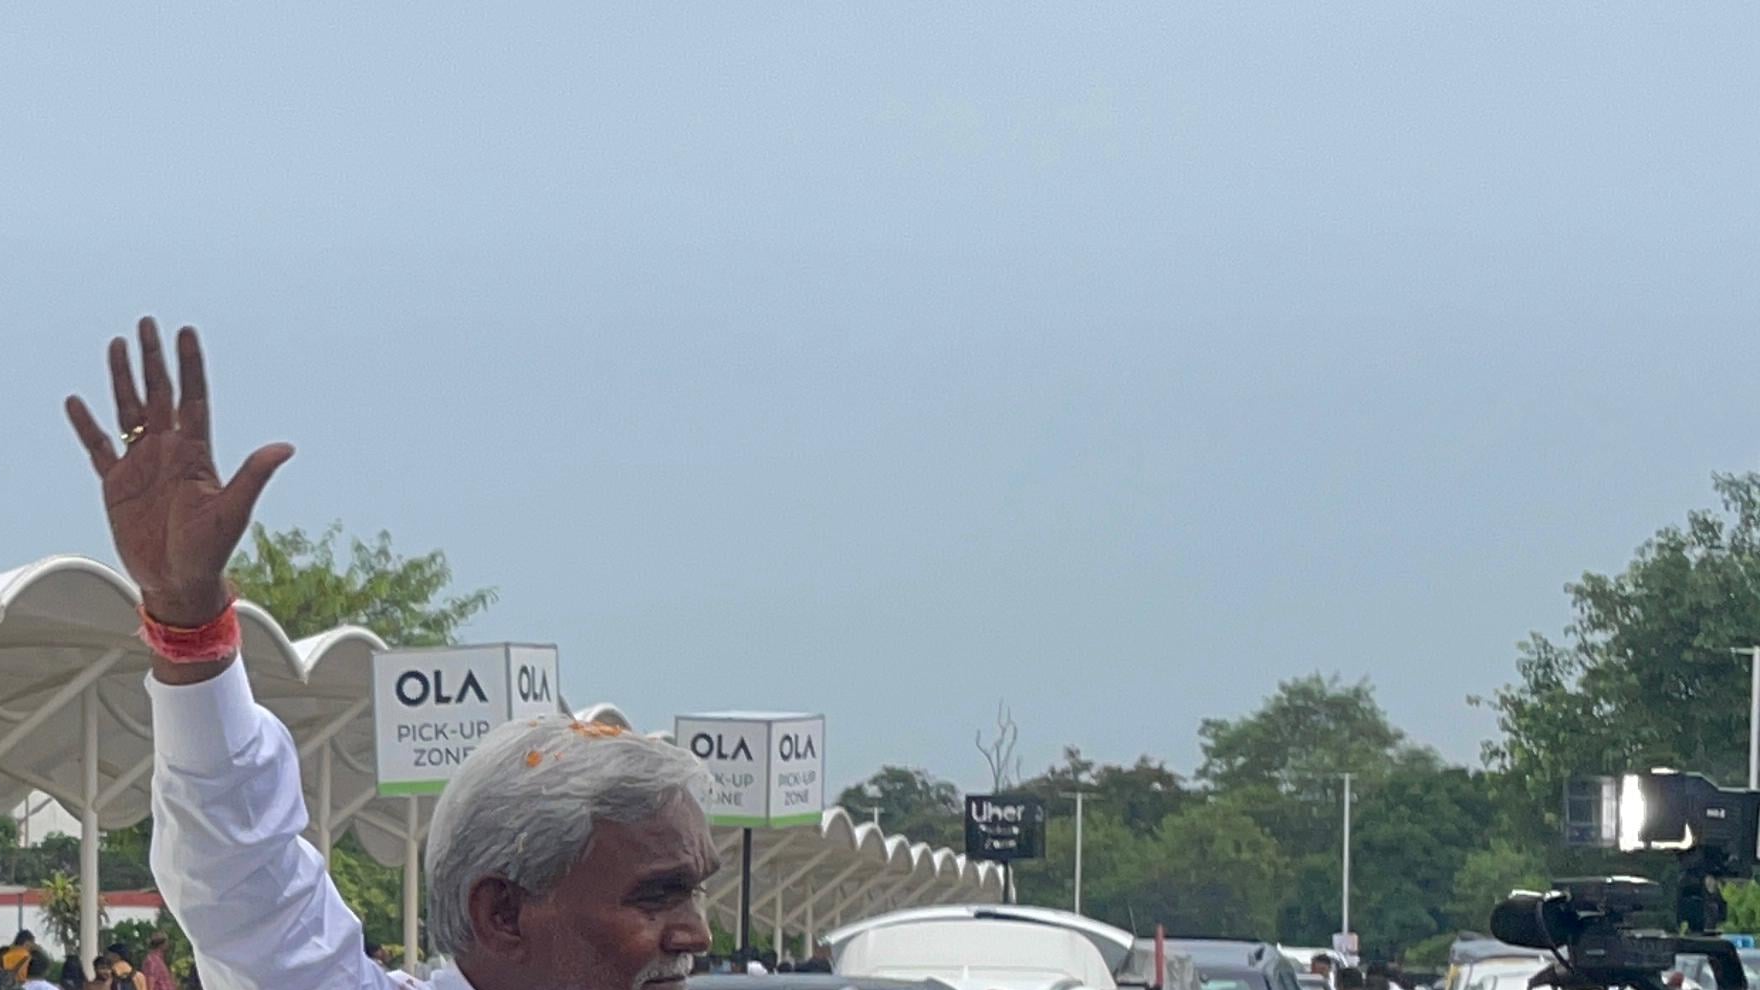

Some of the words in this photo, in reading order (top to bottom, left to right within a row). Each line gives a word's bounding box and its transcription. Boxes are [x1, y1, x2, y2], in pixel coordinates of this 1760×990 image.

[395, 669, 488, 706] OLA
[518, 664, 551, 702] OLA
[397, 720, 489, 742] PICK-UP
[691, 733, 753, 761] OLA
[779, 733, 816, 761] OLA
